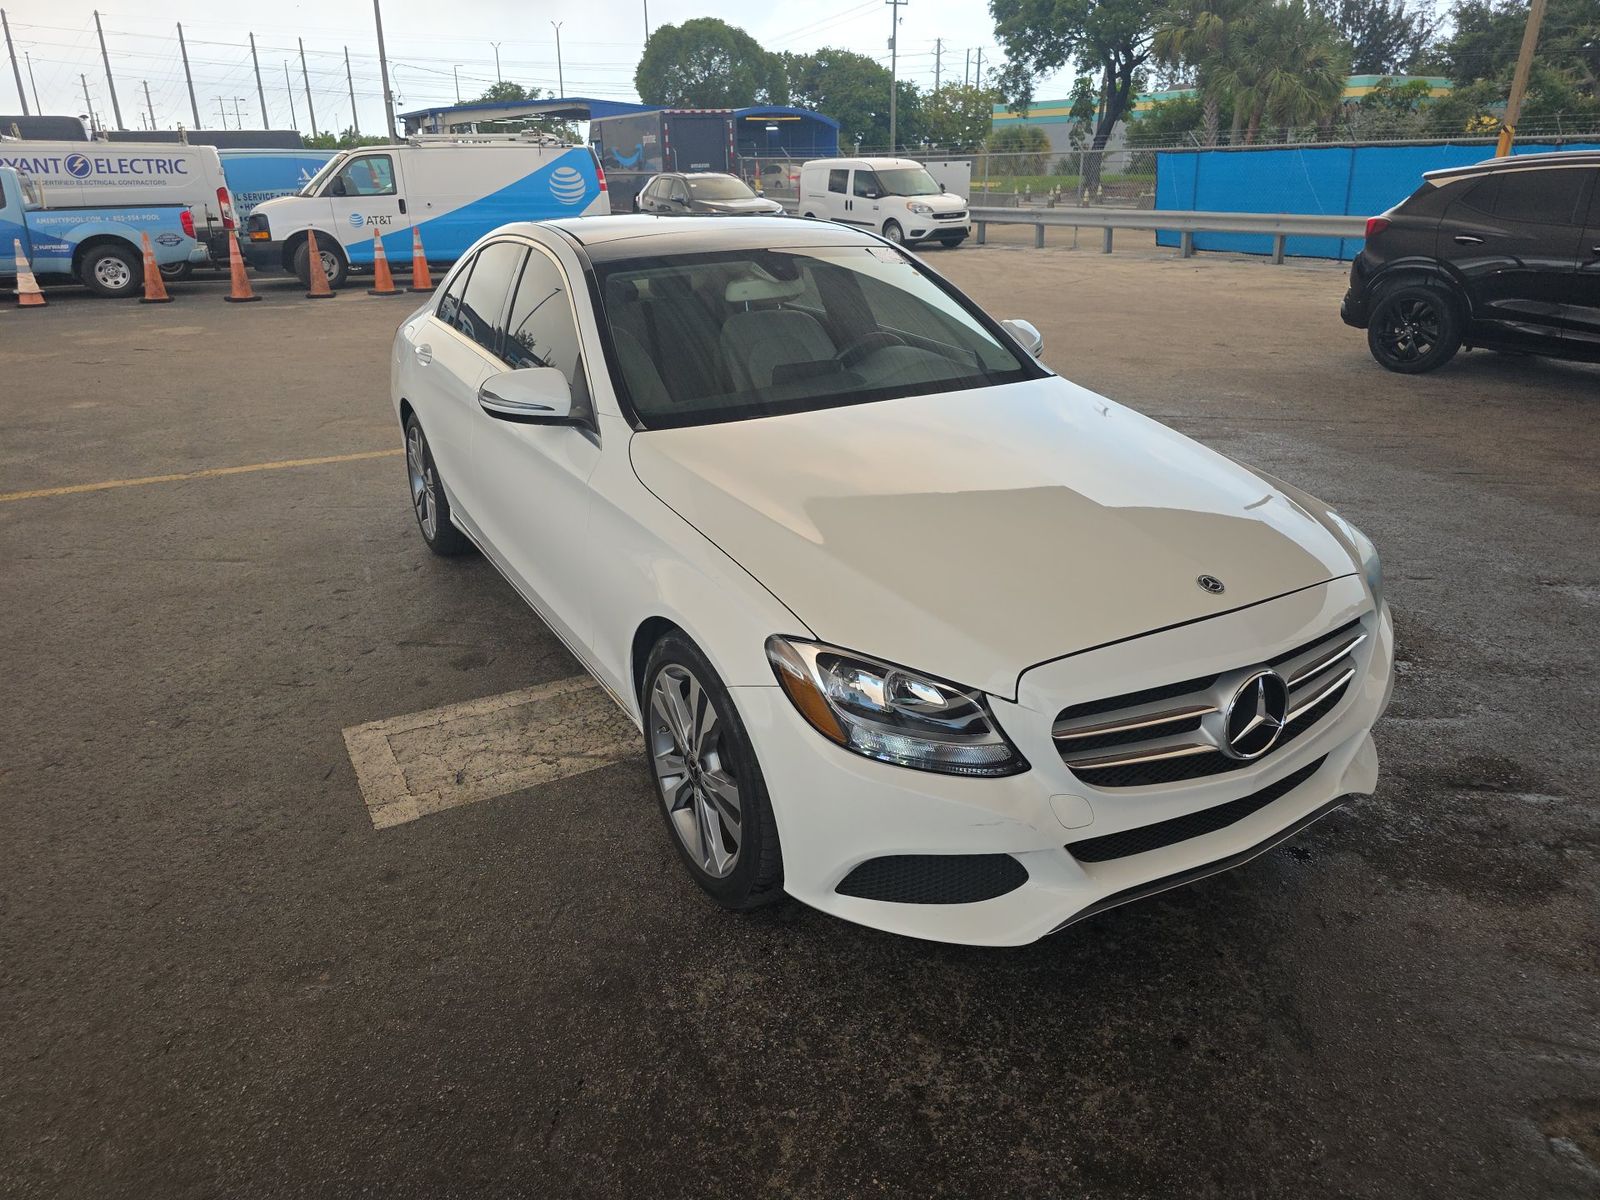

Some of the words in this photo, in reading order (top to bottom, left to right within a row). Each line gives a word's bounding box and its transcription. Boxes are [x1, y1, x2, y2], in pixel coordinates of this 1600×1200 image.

[0, 157, 62, 174] YANT
[95, 158, 188, 175] ELECTRIC
[242, 192, 274, 202] SERVICE
[366, 215, 392, 225] AT&T
